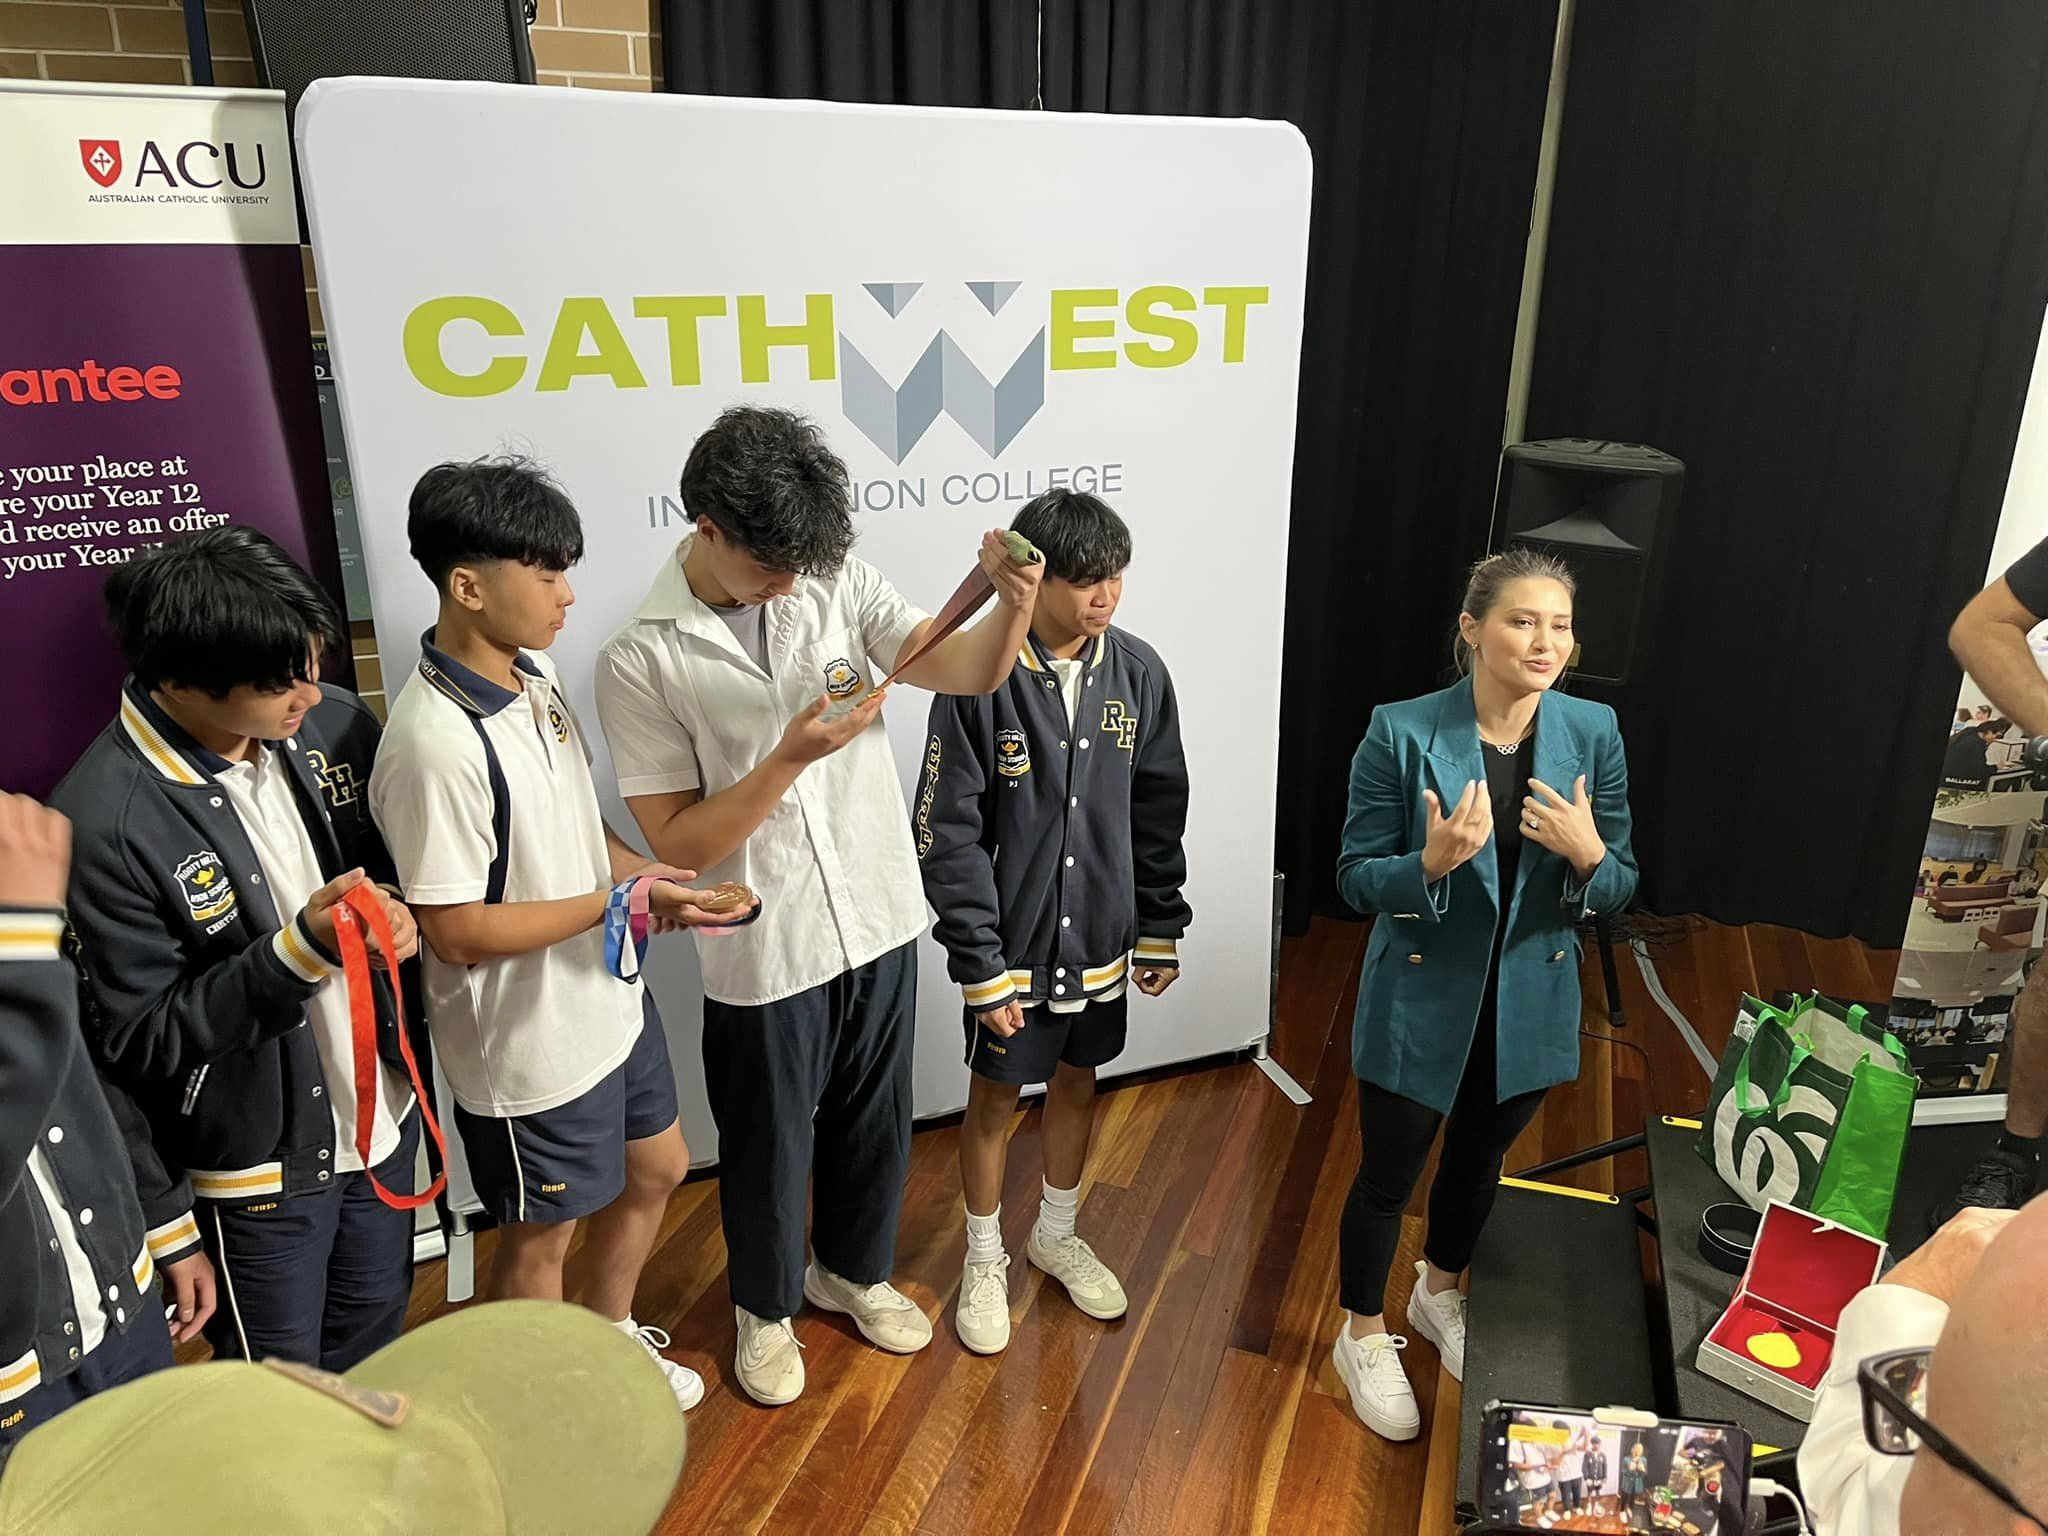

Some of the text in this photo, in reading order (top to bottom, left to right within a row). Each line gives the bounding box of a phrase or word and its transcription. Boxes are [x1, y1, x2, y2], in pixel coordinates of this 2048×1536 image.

[135, 141, 266, 189] ACU
[88, 194, 270, 205] AUSTRALIAN CATHOLIC UNIVERSITY
[9, 465, 75, 491] your
[81, 455, 154, 486] place
[160, 455, 188, 476] at
[942, 464, 1122, 505] COLLEGE
[30, 492, 95, 519] your
[98, 485, 163, 508] Year
[169, 483, 201, 504] 12
[24, 515, 121, 543] receive
[127, 517, 163, 535] an
[168, 507, 230, 533] offer
[1, 552, 68, 580] your
[69, 545, 136, 567] Year
